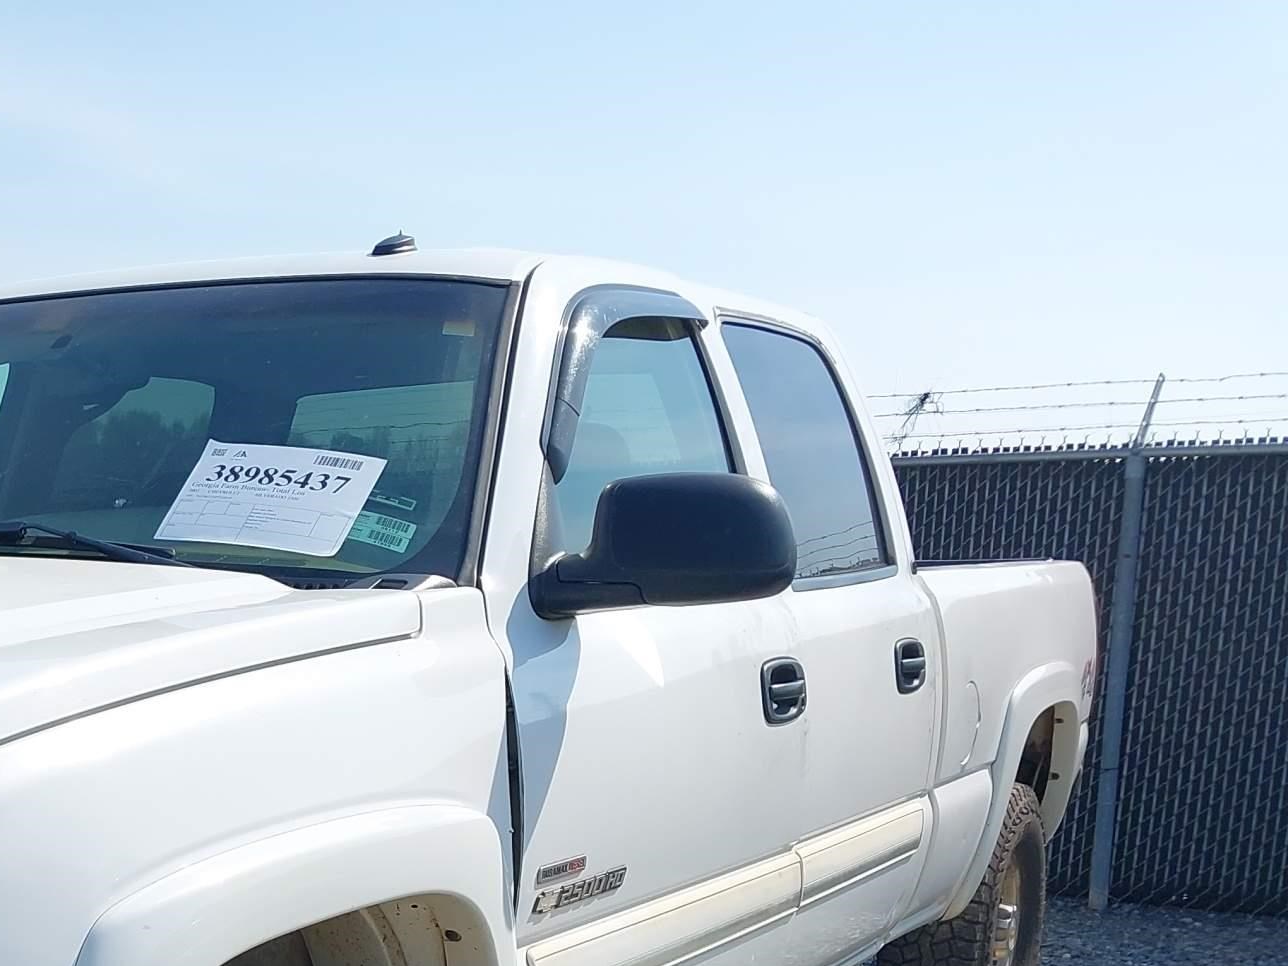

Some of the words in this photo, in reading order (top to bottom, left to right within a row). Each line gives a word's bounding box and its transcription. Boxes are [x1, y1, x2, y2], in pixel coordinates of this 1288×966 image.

[191, 481, 219, 490] Georgia
[271, 486, 291, 496] Total
[205, 463, 353, 495] 38985437
